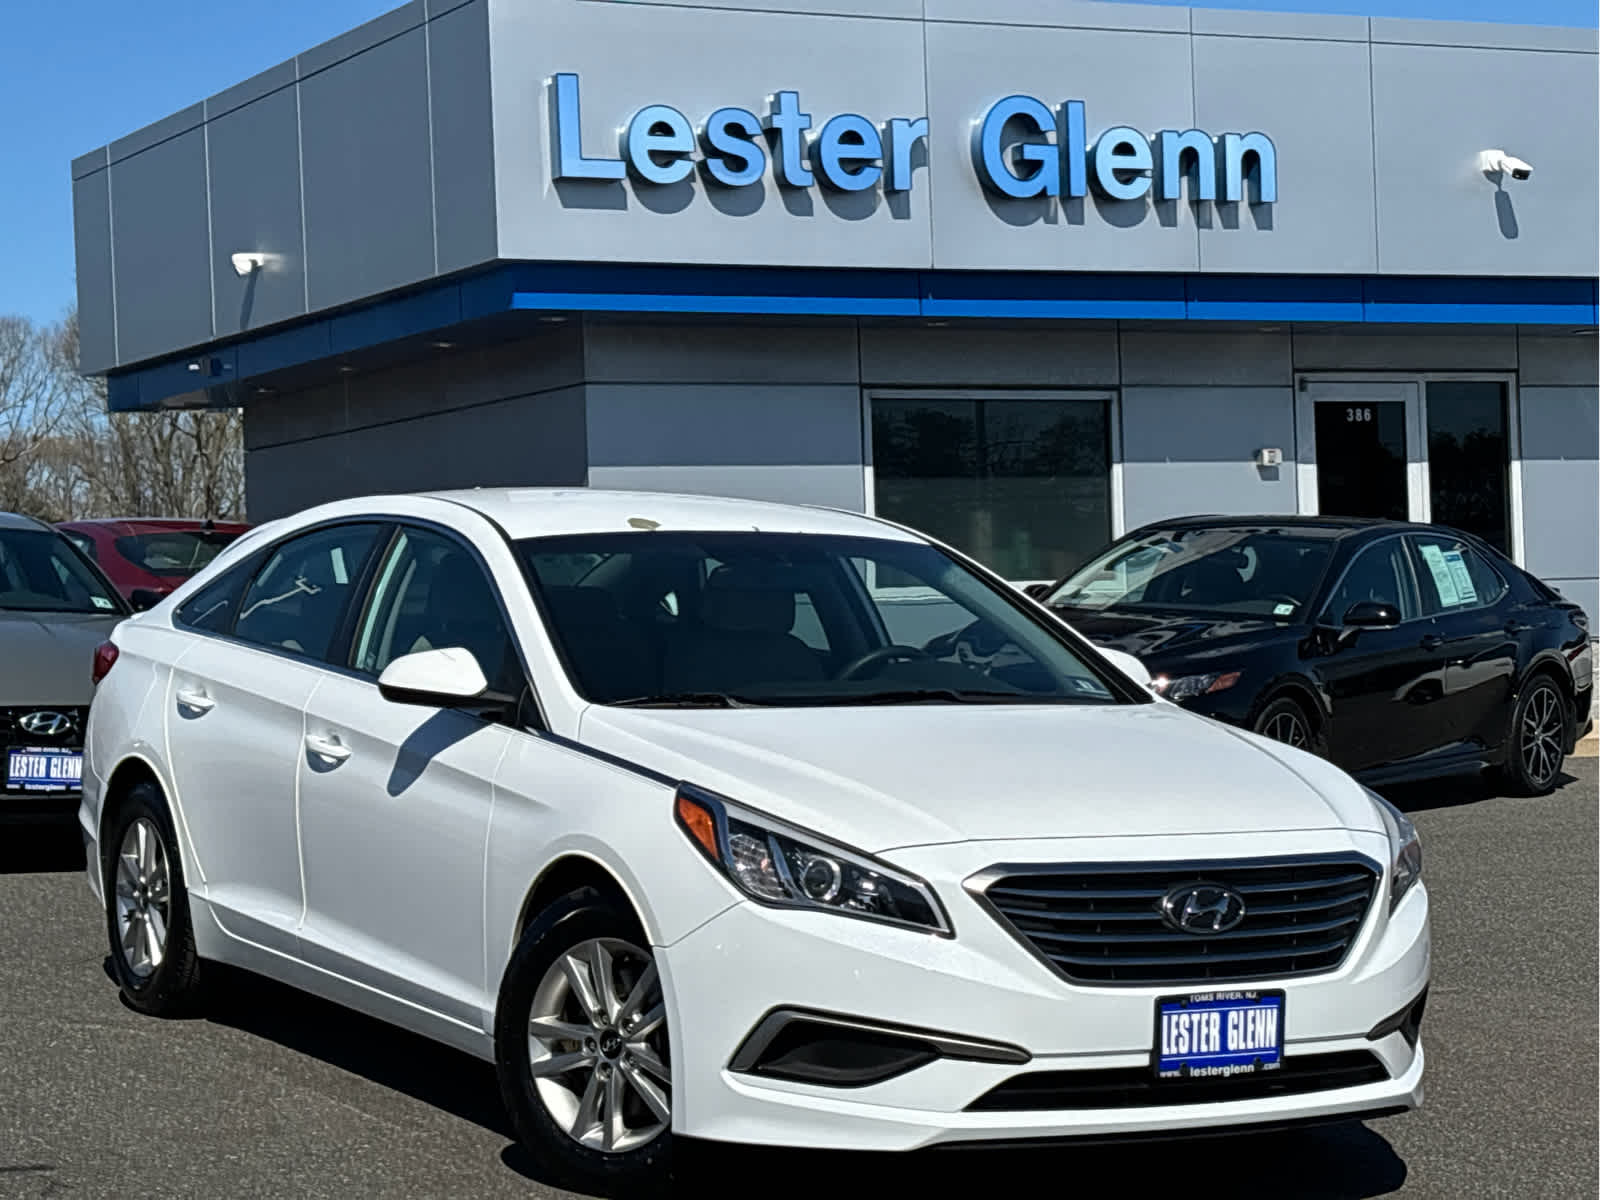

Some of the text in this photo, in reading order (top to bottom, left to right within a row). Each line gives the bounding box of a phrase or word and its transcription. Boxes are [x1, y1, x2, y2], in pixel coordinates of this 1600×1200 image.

[550, 72, 1278, 205] Lester Glenn
[1346, 408, 1371, 421] 386
[9, 755, 82, 779] LESTER GLENN
[1162, 1008, 1278, 1055] LESTER GLENN
[1190, 1063, 1255, 1077] lesterglenn
